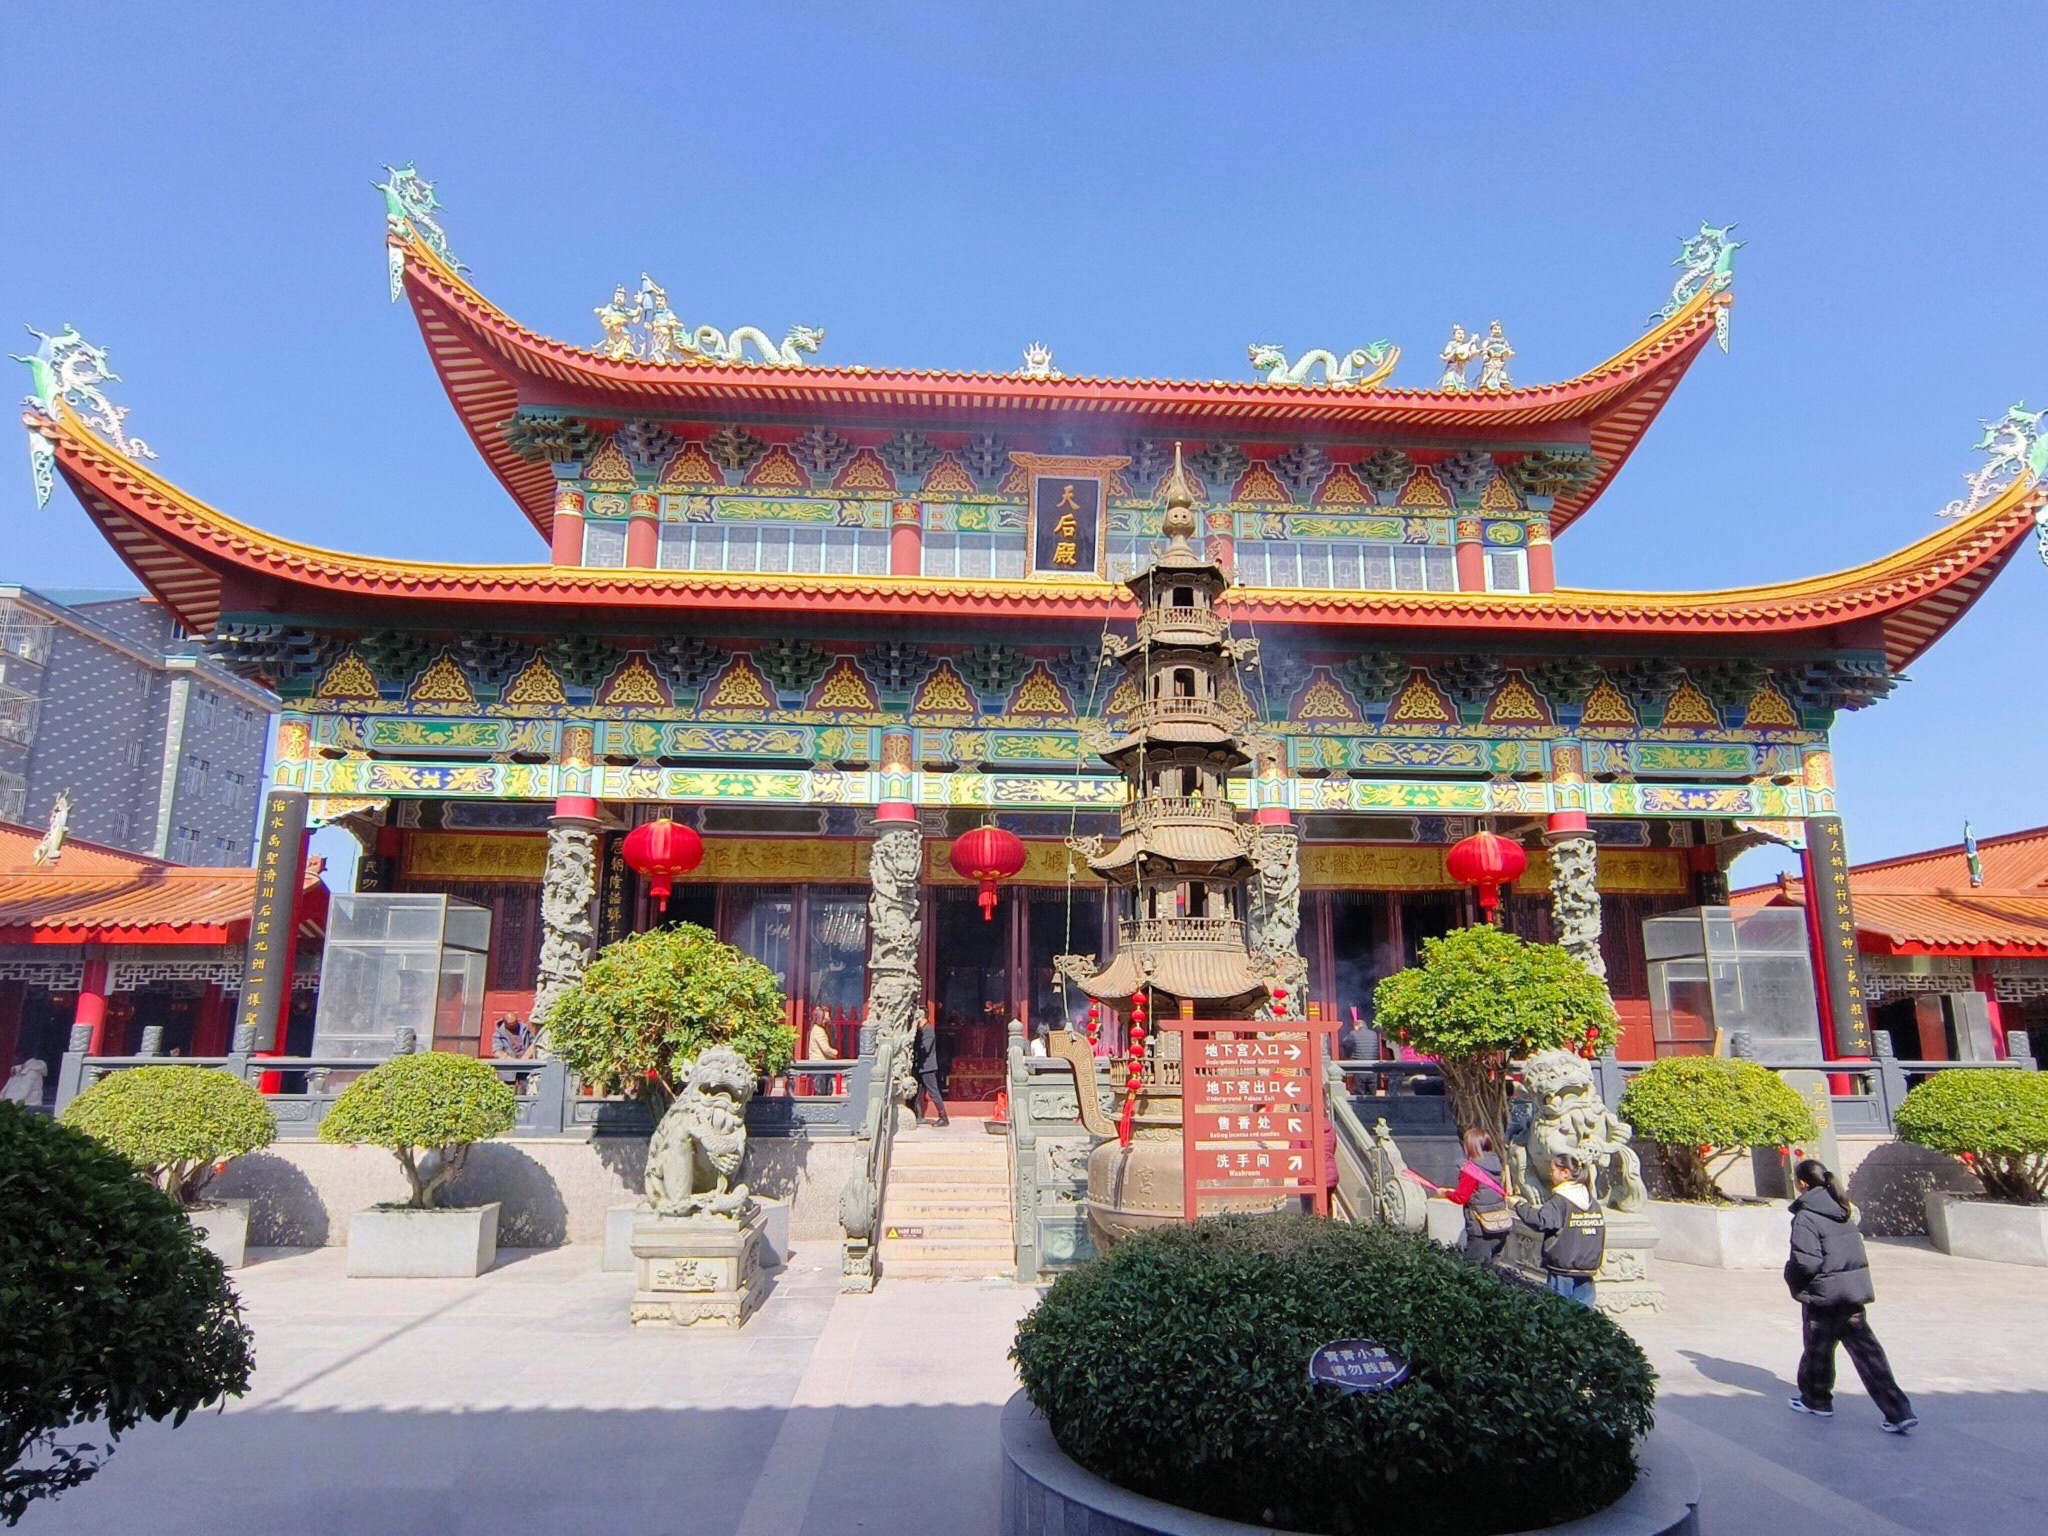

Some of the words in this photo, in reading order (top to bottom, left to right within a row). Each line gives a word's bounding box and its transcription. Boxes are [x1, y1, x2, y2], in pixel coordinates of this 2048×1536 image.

[1052, 484, 1080, 566] 天后殿
[1204, 1043, 1279, 1057] 地下宫入口
[1206, 1080, 1281, 1095] 地下宫出口
[1206, 1095, 1242, 1103] Underground
[1217, 1115, 1271, 1131] 售香处
[1216, 1153, 1270, 1168] 洗手间
[1229, 1169, 1261, 1177] Washroom
[1324, 1347, 1389, 1363] 青青小草
